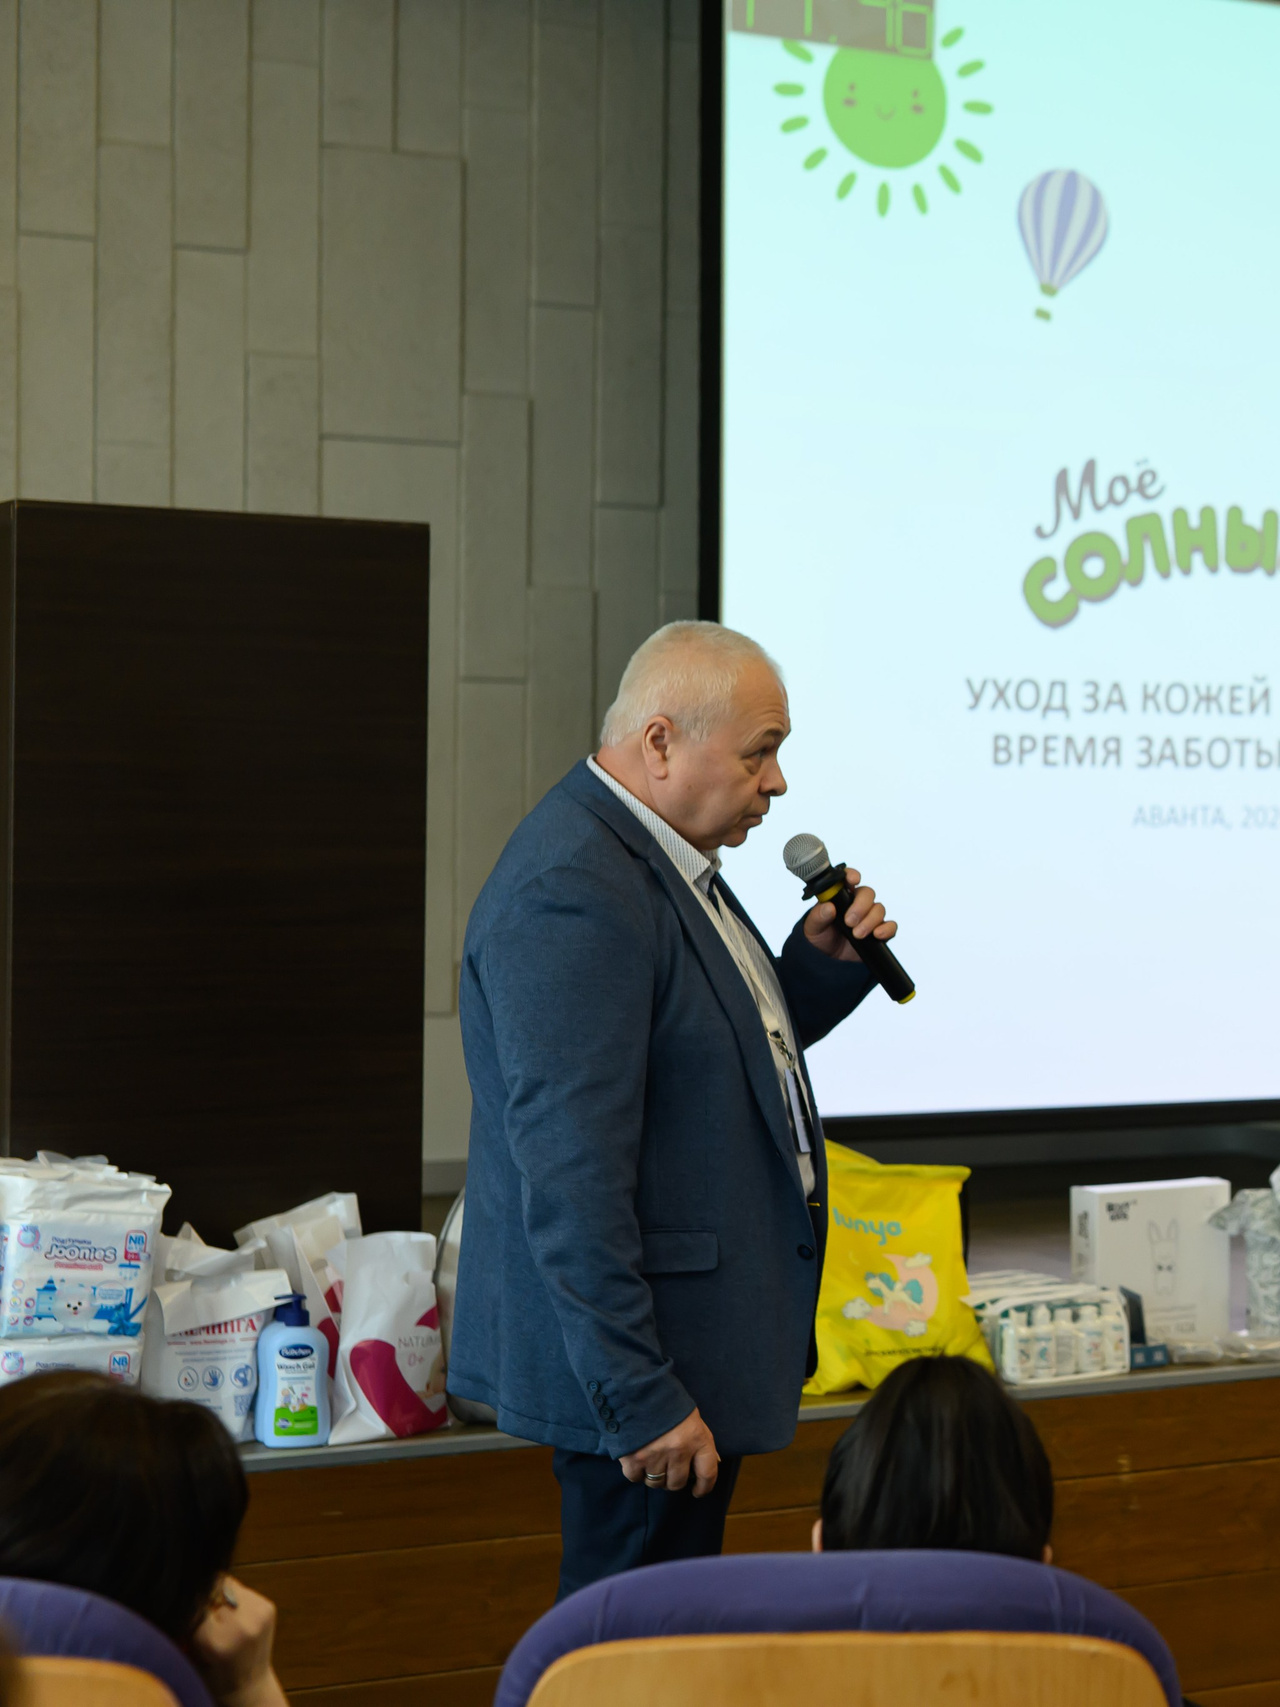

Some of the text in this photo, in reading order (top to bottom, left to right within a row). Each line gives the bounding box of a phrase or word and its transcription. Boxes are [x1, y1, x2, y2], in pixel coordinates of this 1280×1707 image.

[1034, 458, 1166, 540] Моё
[965, 676, 1071, 721] УХОД
[1082, 680, 1128, 714] ЗА
[1141, 676, 1271, 718] КОЖЕЙ
[992, 733, 1123, 770] ВРЕМЯ
[1132, 804, 1234, 832] АВАНТА,
[128, 1235, 145, 1245] NB
